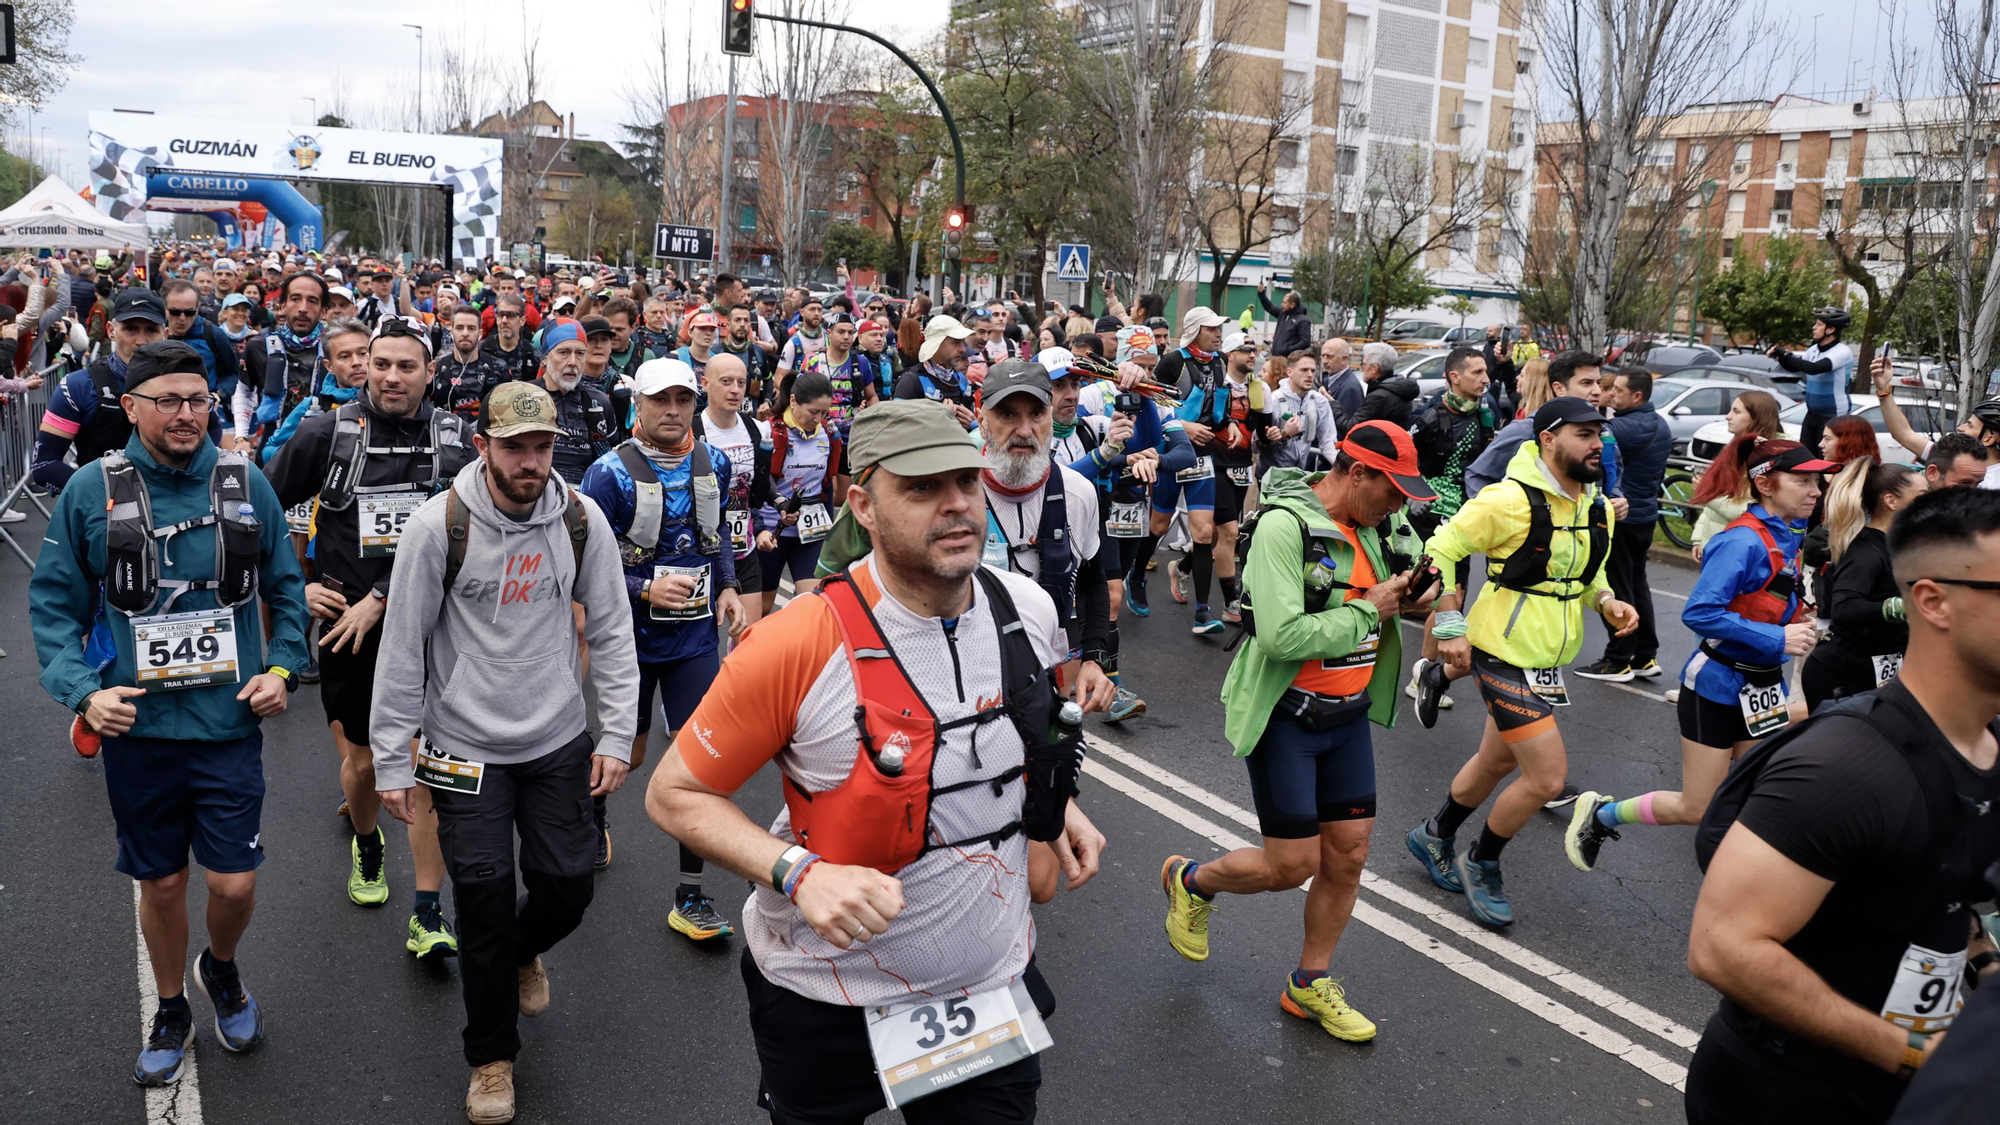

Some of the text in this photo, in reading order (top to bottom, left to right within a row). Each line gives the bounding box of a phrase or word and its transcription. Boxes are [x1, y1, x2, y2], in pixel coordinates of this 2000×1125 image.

[169, 138, 258, 158] GUZMÁN
[348, 150, 436, 169] EL BUENO
[167, 175, 249, 192] CABELLO
[674, 227, 698, 237] ACCESO
[671, 236, 699, 254] MTB
[804, 511, 827, 528] 911
[1112, 509, 1139, 524] 142
[506, 552, 543, 577] I'M
[126, 562, 134, 591] AONIJIE
[176, 622, 203, 631] GUZMÁN
[148, 635, 220, 668] 549
[1532, 666, 1559, 686] 256
[1880, 662, 1901, 681] 65
[163, 676, 211, 688] TRAIL RUNING
[1480, 673, 1532, 697] GRANADA
[1749, 686, 1780, 714] 606
[691, 719, 722, 759] TEAMERGY
[433, 774, 455, 784] RUNING
[1427, 843, 1442, 861] GORE
[910, 995, 977, 1049] 35
[929, 1070, 958, 1087] TRAIL
[957, 1054, 994, 1077] RUNING
